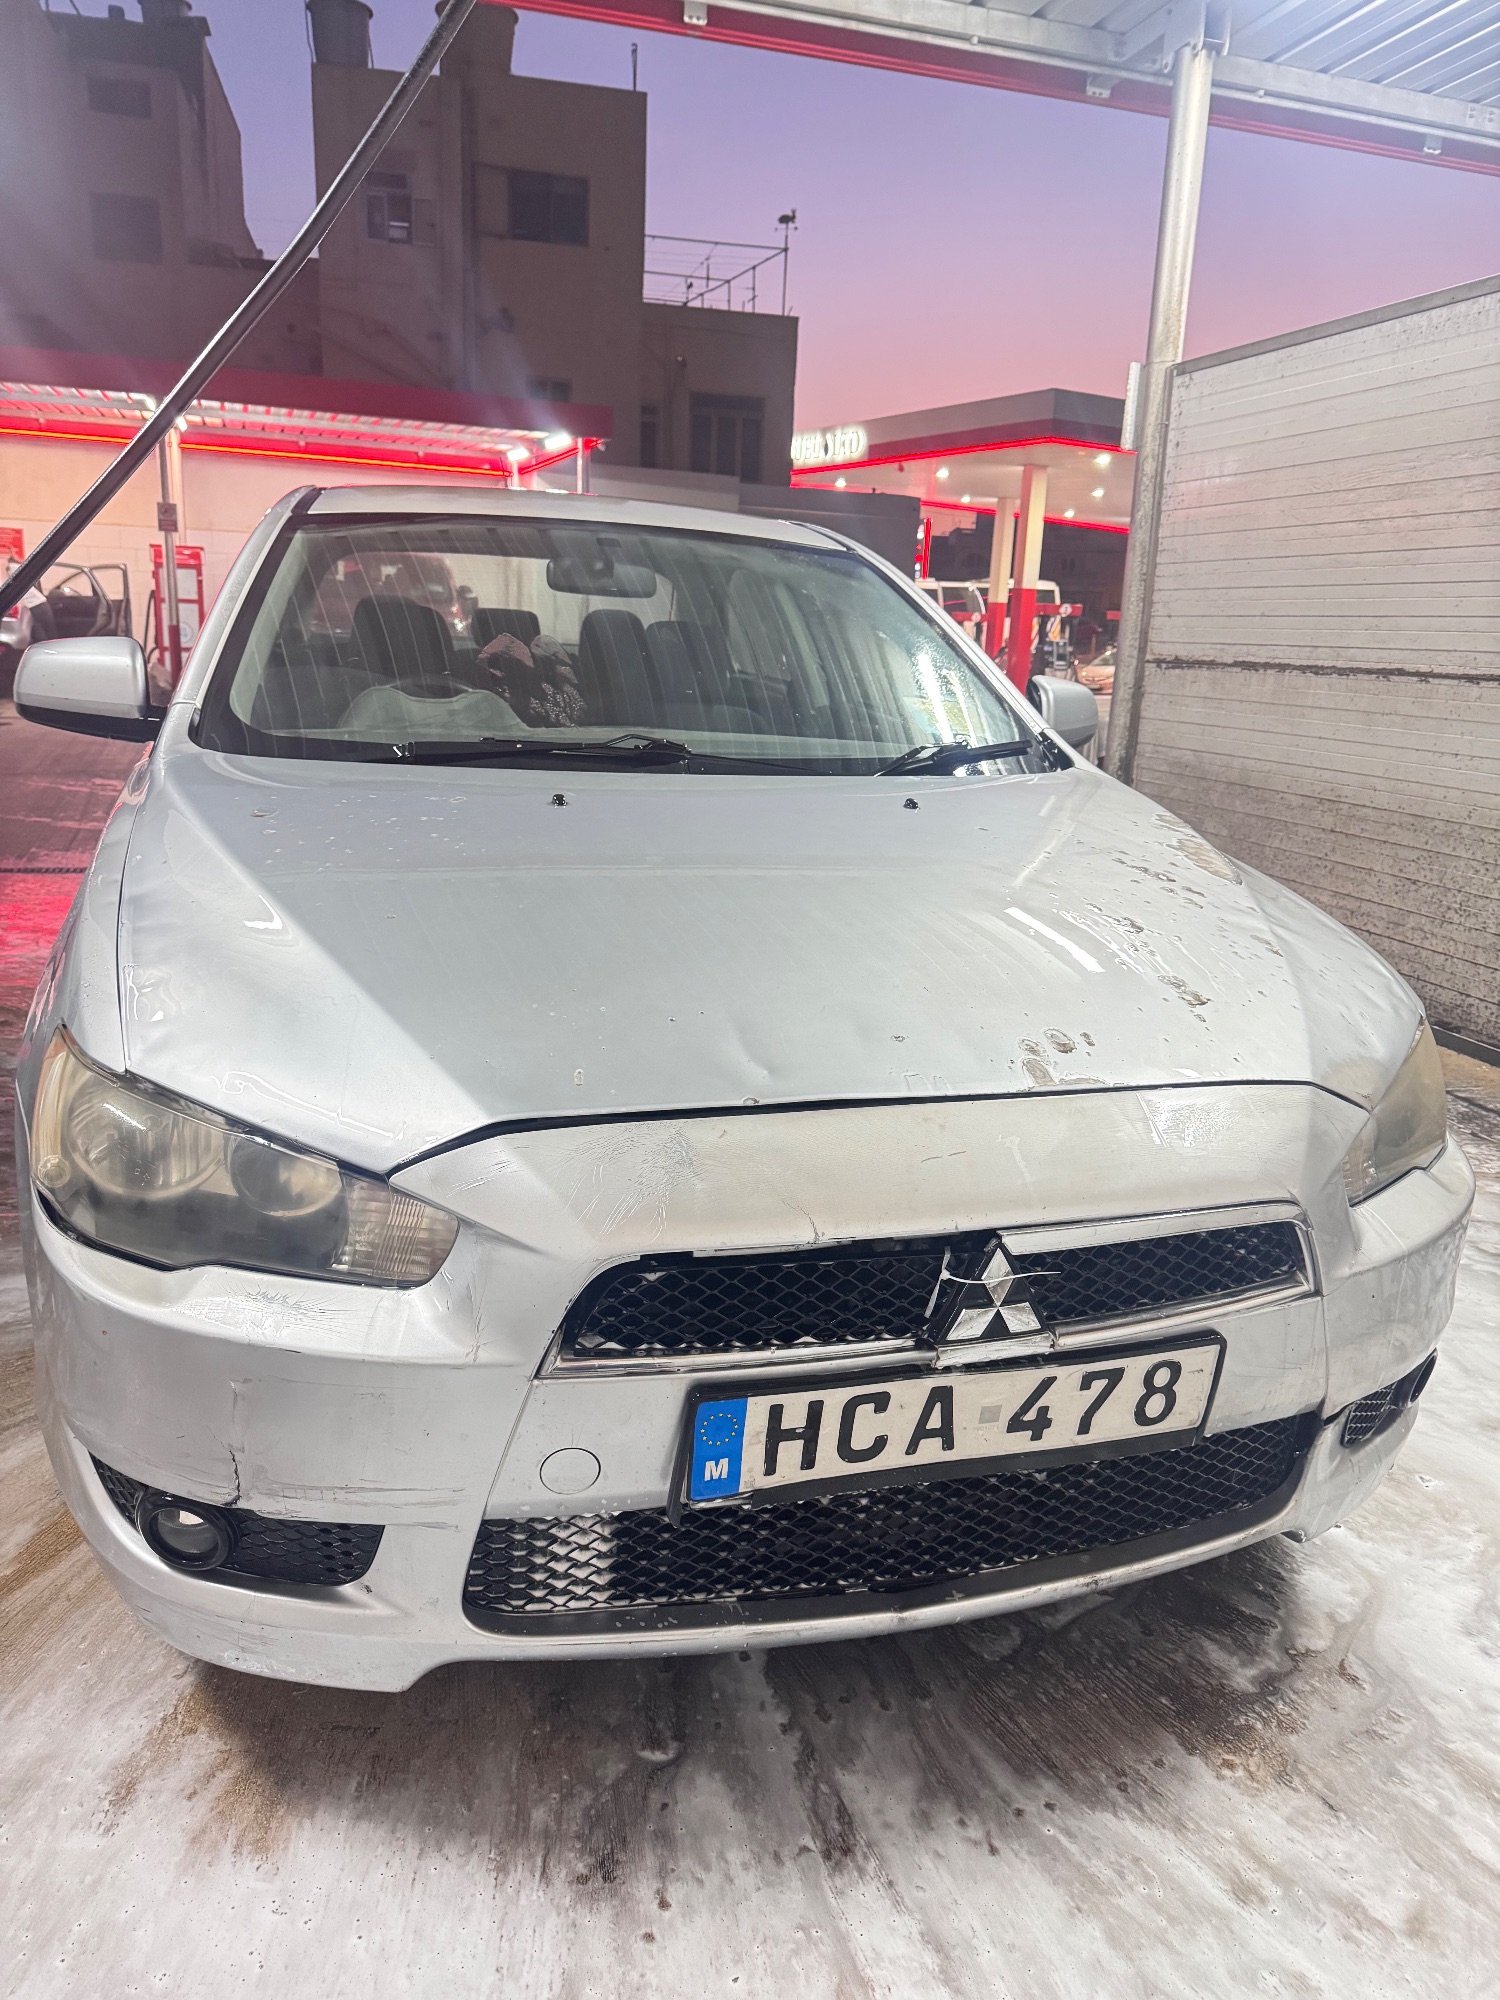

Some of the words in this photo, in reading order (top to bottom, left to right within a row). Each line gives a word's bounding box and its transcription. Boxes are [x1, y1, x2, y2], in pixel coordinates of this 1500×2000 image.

[763, 1386, 955, 1476] HCA
[1006, 1360, 1182, 1441] 478
[704, 1458, 729, 1481] M
